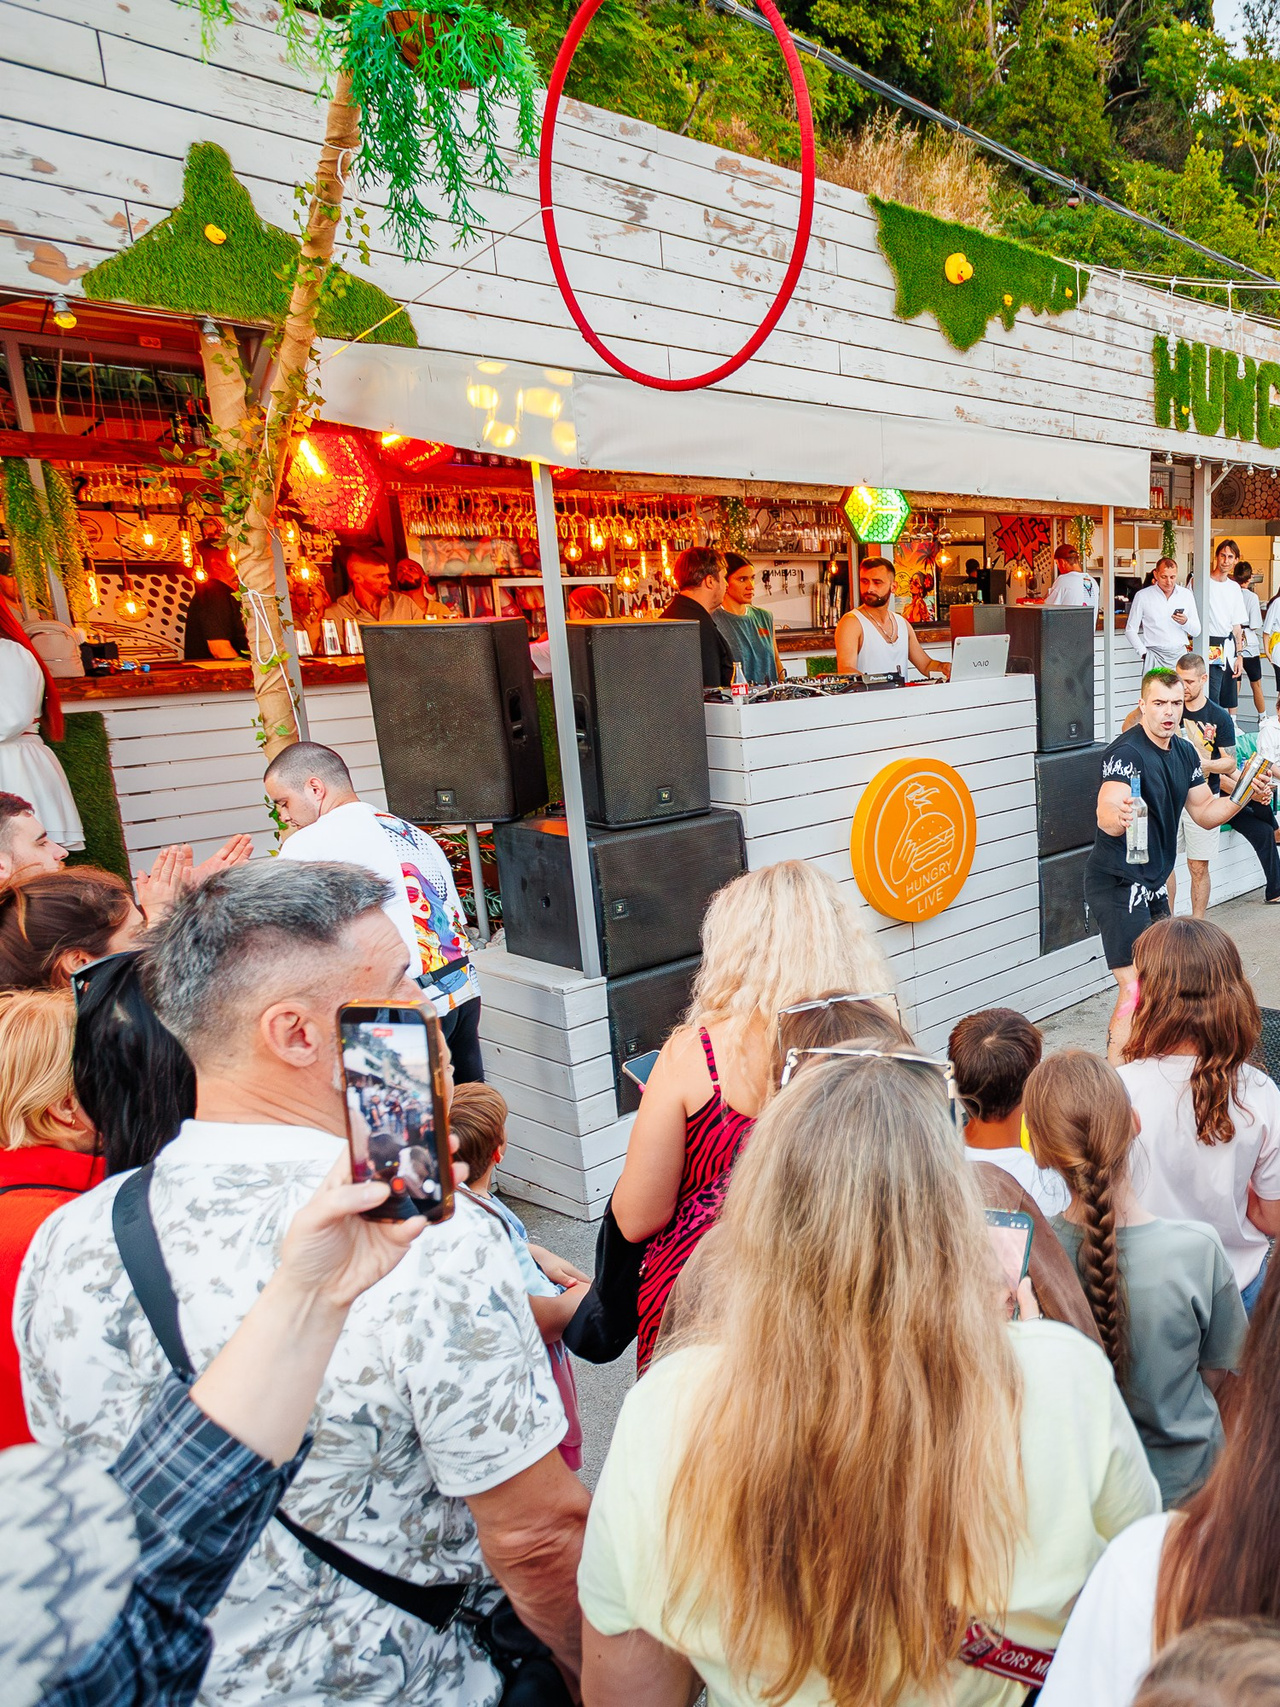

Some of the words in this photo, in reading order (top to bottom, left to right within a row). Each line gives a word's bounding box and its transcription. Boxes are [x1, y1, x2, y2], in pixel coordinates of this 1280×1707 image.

[972, 660, 990, 668] VAIO
[907, 859, 952, 896] HUNGRY
[918, 887, 944, 914] LIVE
